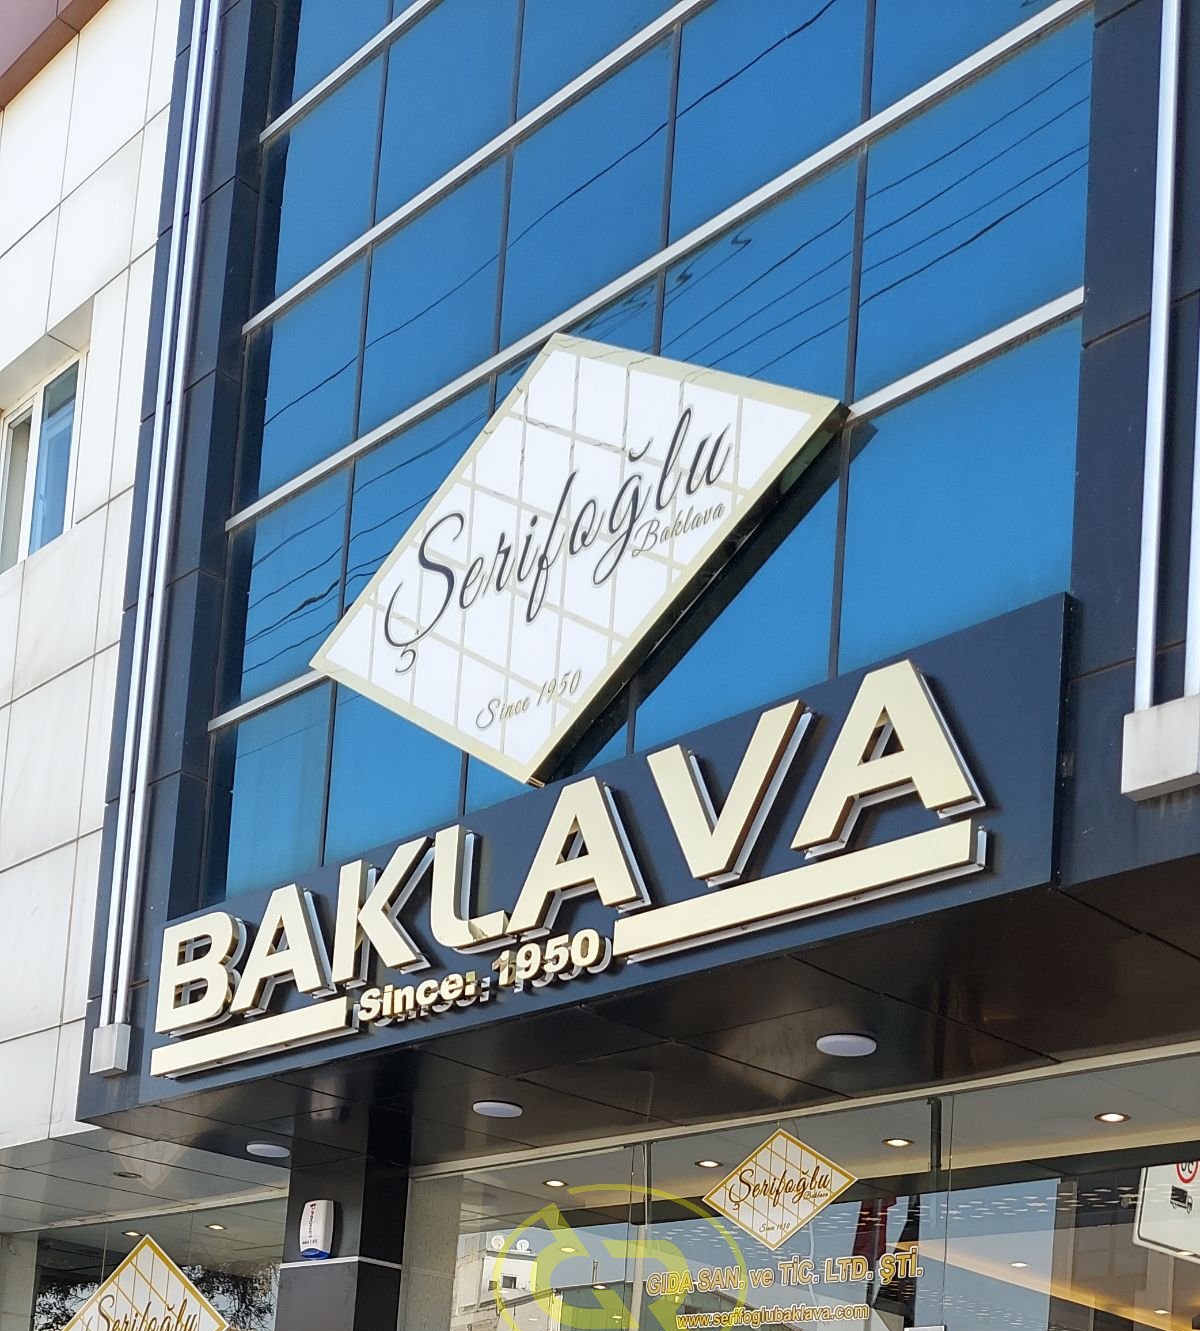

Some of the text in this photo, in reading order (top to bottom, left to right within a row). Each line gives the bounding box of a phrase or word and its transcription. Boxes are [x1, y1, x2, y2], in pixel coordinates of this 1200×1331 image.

[384, 406, 732, 674] Şerifoğlu
[632, 503, 724, 557] Baklava
[476, 669, 581, 729] Since 1950
[155, 659, 984, 1035] BAKLAVA
[492, 928, 601, 987] 1950
[728, 1165, 831, 1210] Şerifoğlu
[647, 1246, 923, 1297] GIDA SAN. ve TİC. LTD. ŞTİ.
[676, 1303, 869, 1330] www.serifoglubaklava.com
